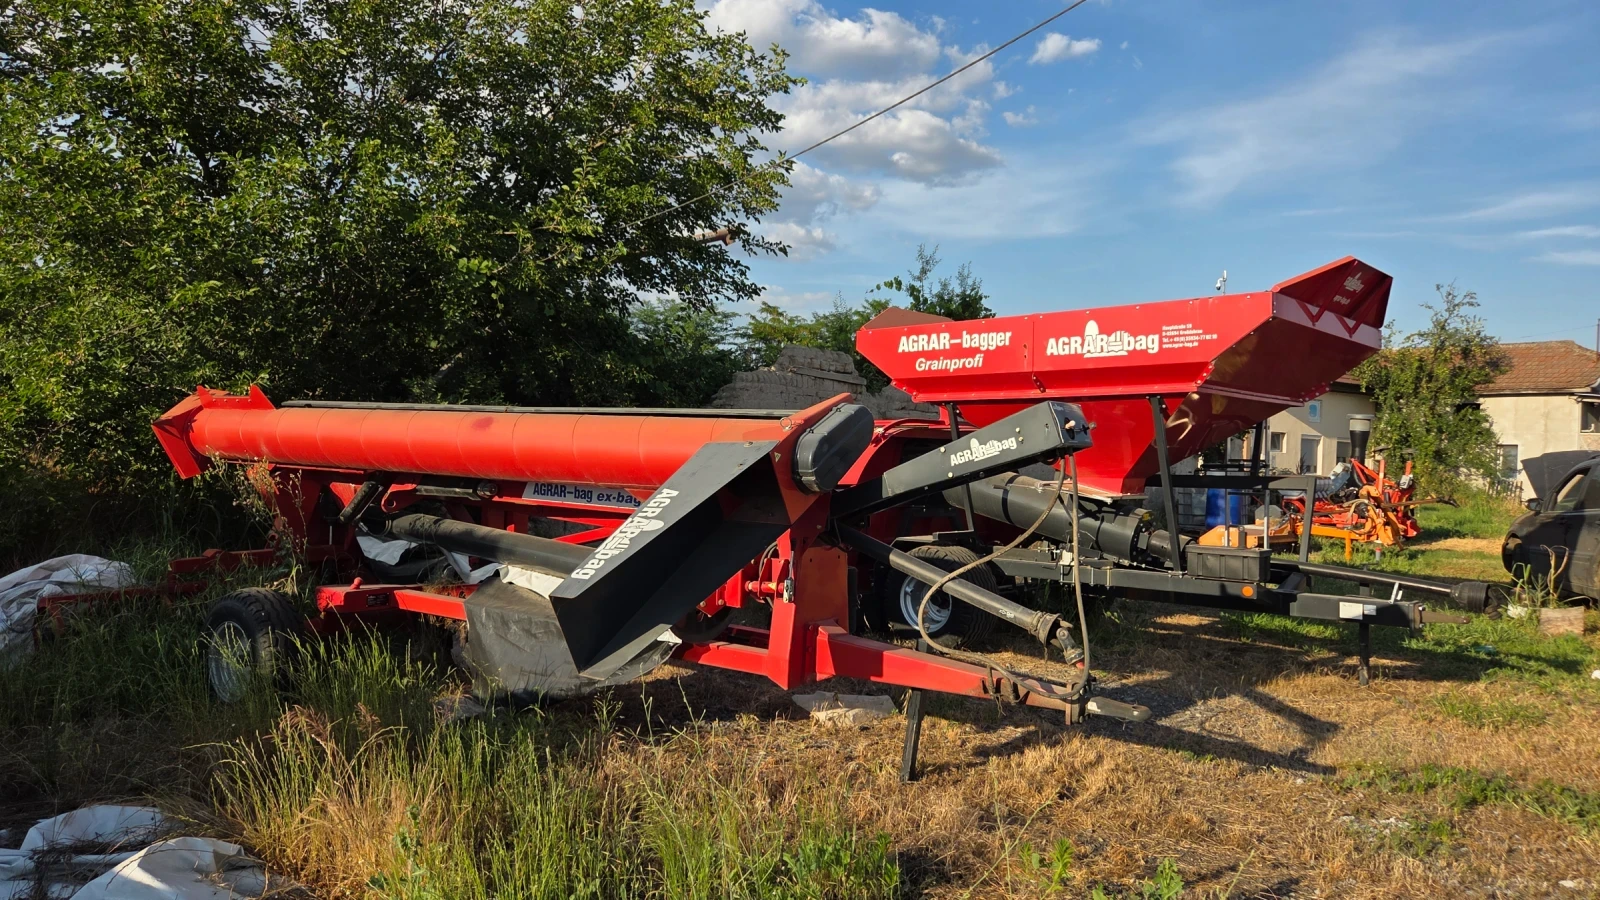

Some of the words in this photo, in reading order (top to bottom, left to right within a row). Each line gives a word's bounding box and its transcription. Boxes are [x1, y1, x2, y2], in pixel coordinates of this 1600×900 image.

[898, 331, 1012, 353] AGRAR-bagger
[1046, 331, 1108, 356] AGRAR
[915, 354, 983, 373] Grainprofi
[533, 482, 593, 502] AGRAR-bag
